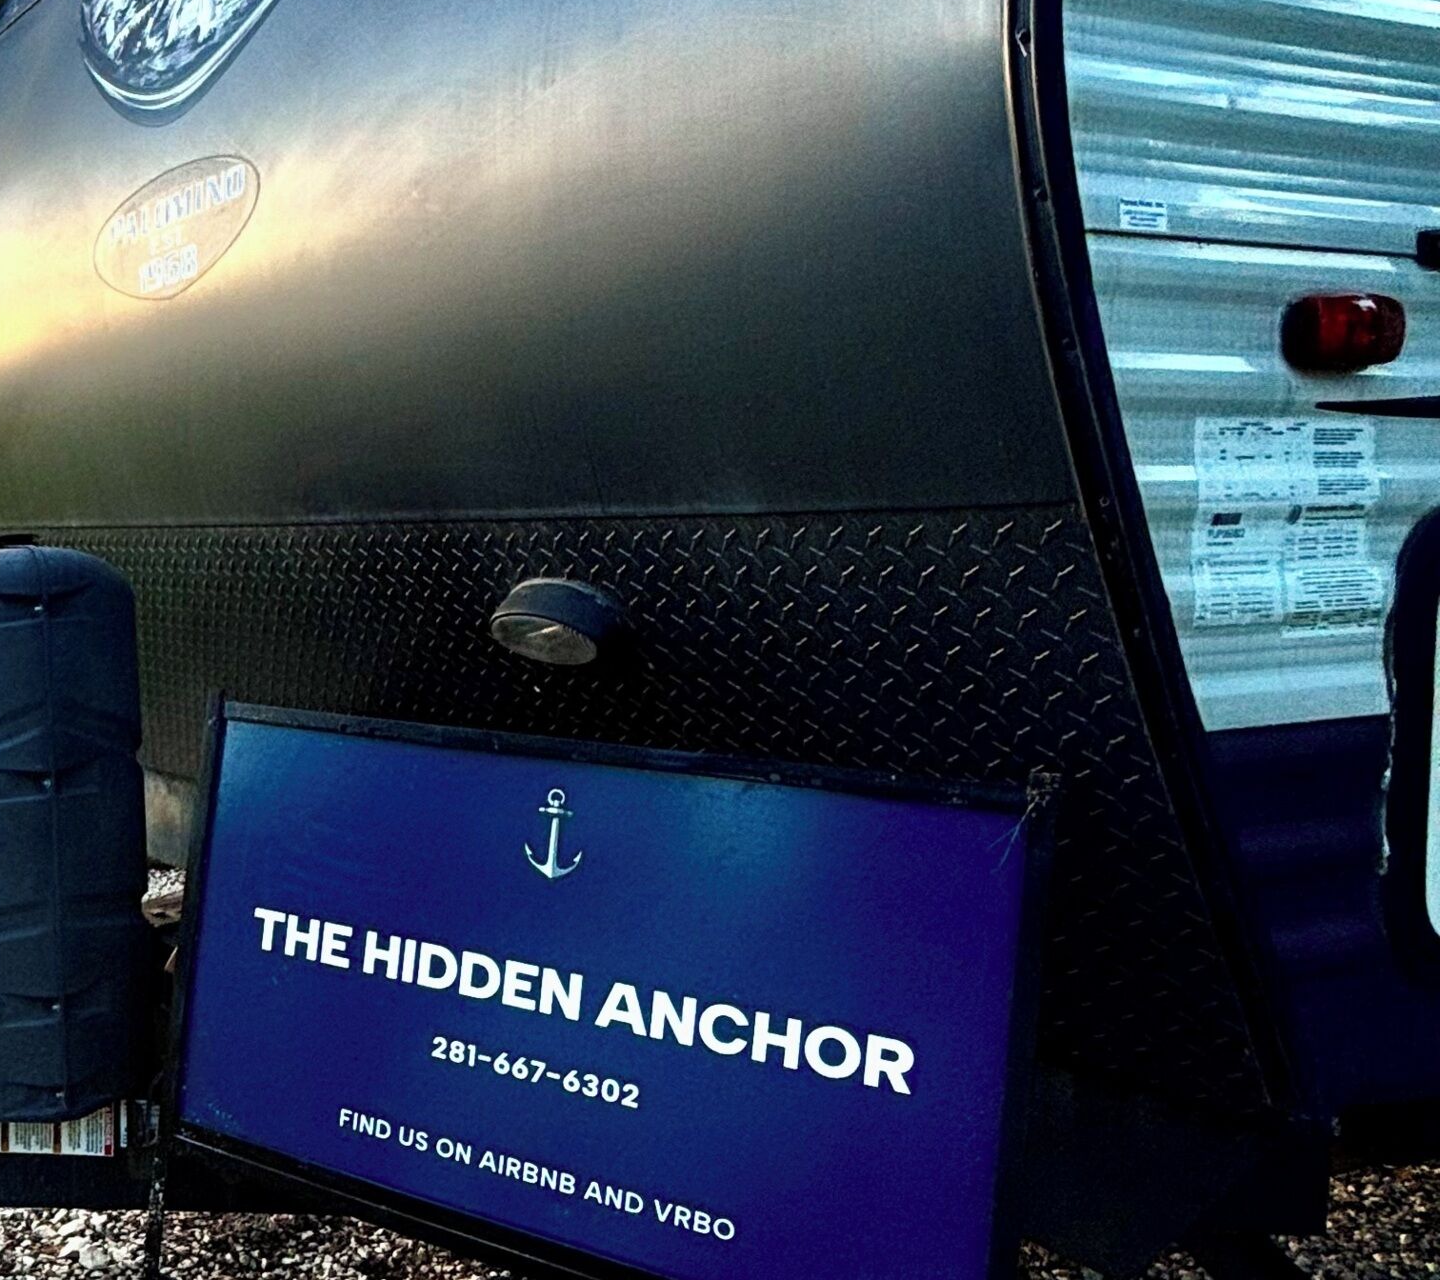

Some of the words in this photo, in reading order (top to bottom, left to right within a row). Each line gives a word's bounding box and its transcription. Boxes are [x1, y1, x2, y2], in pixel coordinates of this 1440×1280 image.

[109, 164, 246, 244] PALOMINO
[253, 907, 354, 969] THE
[362, 930, 584, 1022] HIDDEN
[594, 982, 915, 1095] ANCHOR
[431, 1036, 640, 1109] 281-667-6302
[339, 1108, 392, 1140] FIND
[398, 1126, 429, 1152] US
[435, 1137, 472, 1165] ON
[478, 1150, 576, 1195] AIRBNB
[583, 1181, 644, 1214] AND
[653, 1198, 735, 1241] VRBO
